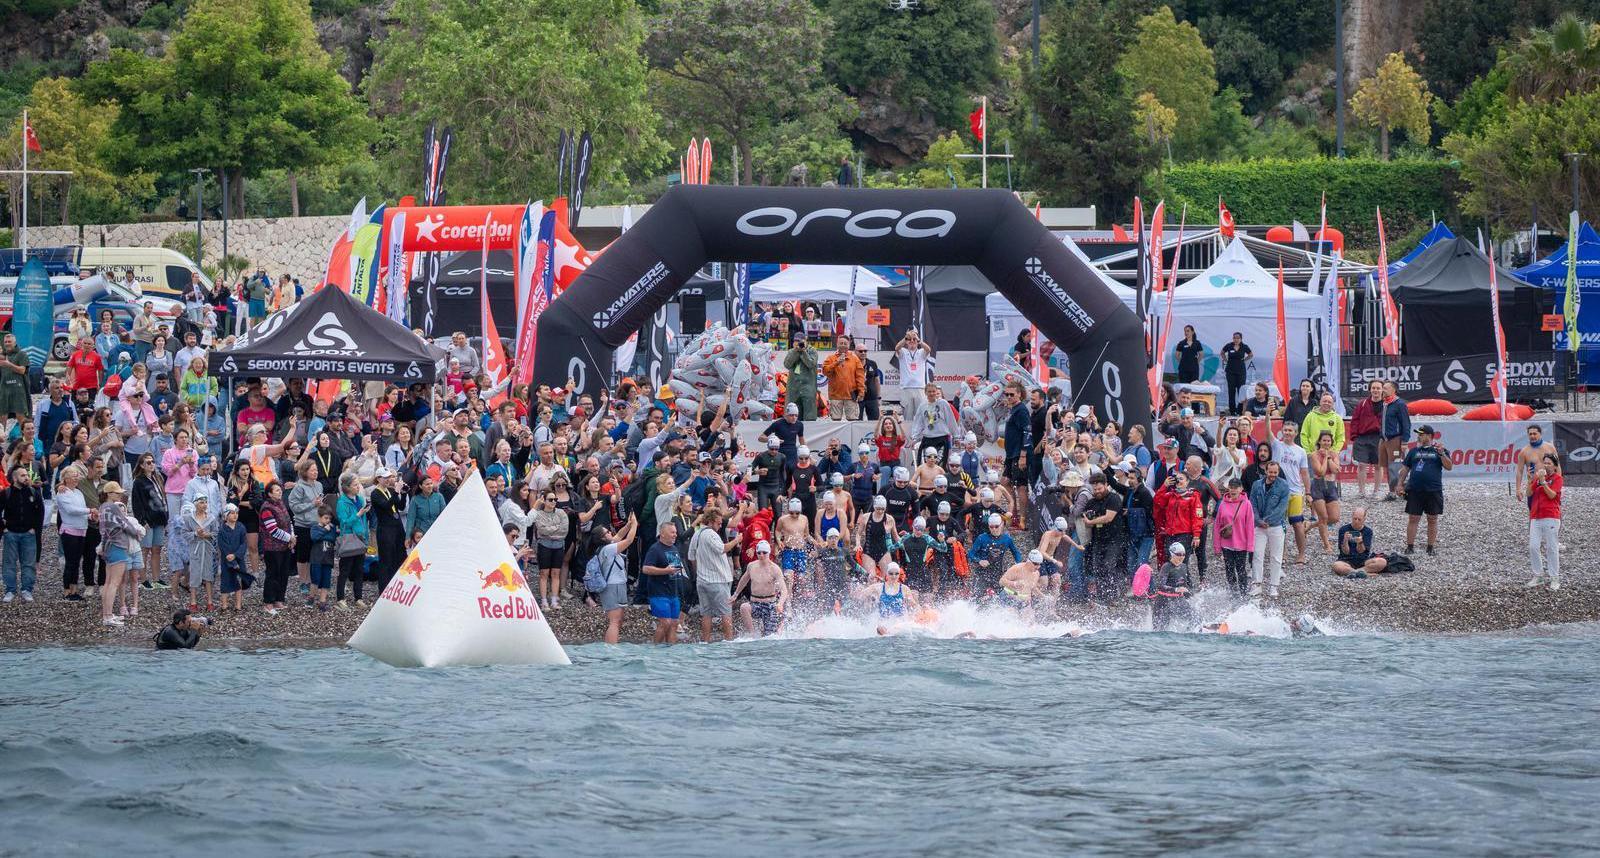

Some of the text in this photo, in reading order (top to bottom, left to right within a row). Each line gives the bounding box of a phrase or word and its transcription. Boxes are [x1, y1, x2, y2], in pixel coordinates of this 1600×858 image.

[736, 207, 957, 239] orca
[645, 269, 671, 293] ANTALYA
[1541, 277, 1600, 289] X-WERS
[1063, 308, 1088, 333] ANTALYA
[247, 358, 396, 375] SEDOXY SPORTS EVENTS
[1350, 365, 1422, 382] SEDOXY
[1521, 377, 1556, 386] EVENTS
[392, 580, 421, 607] Bull
[477, 595, 540, 621] Red Bull
